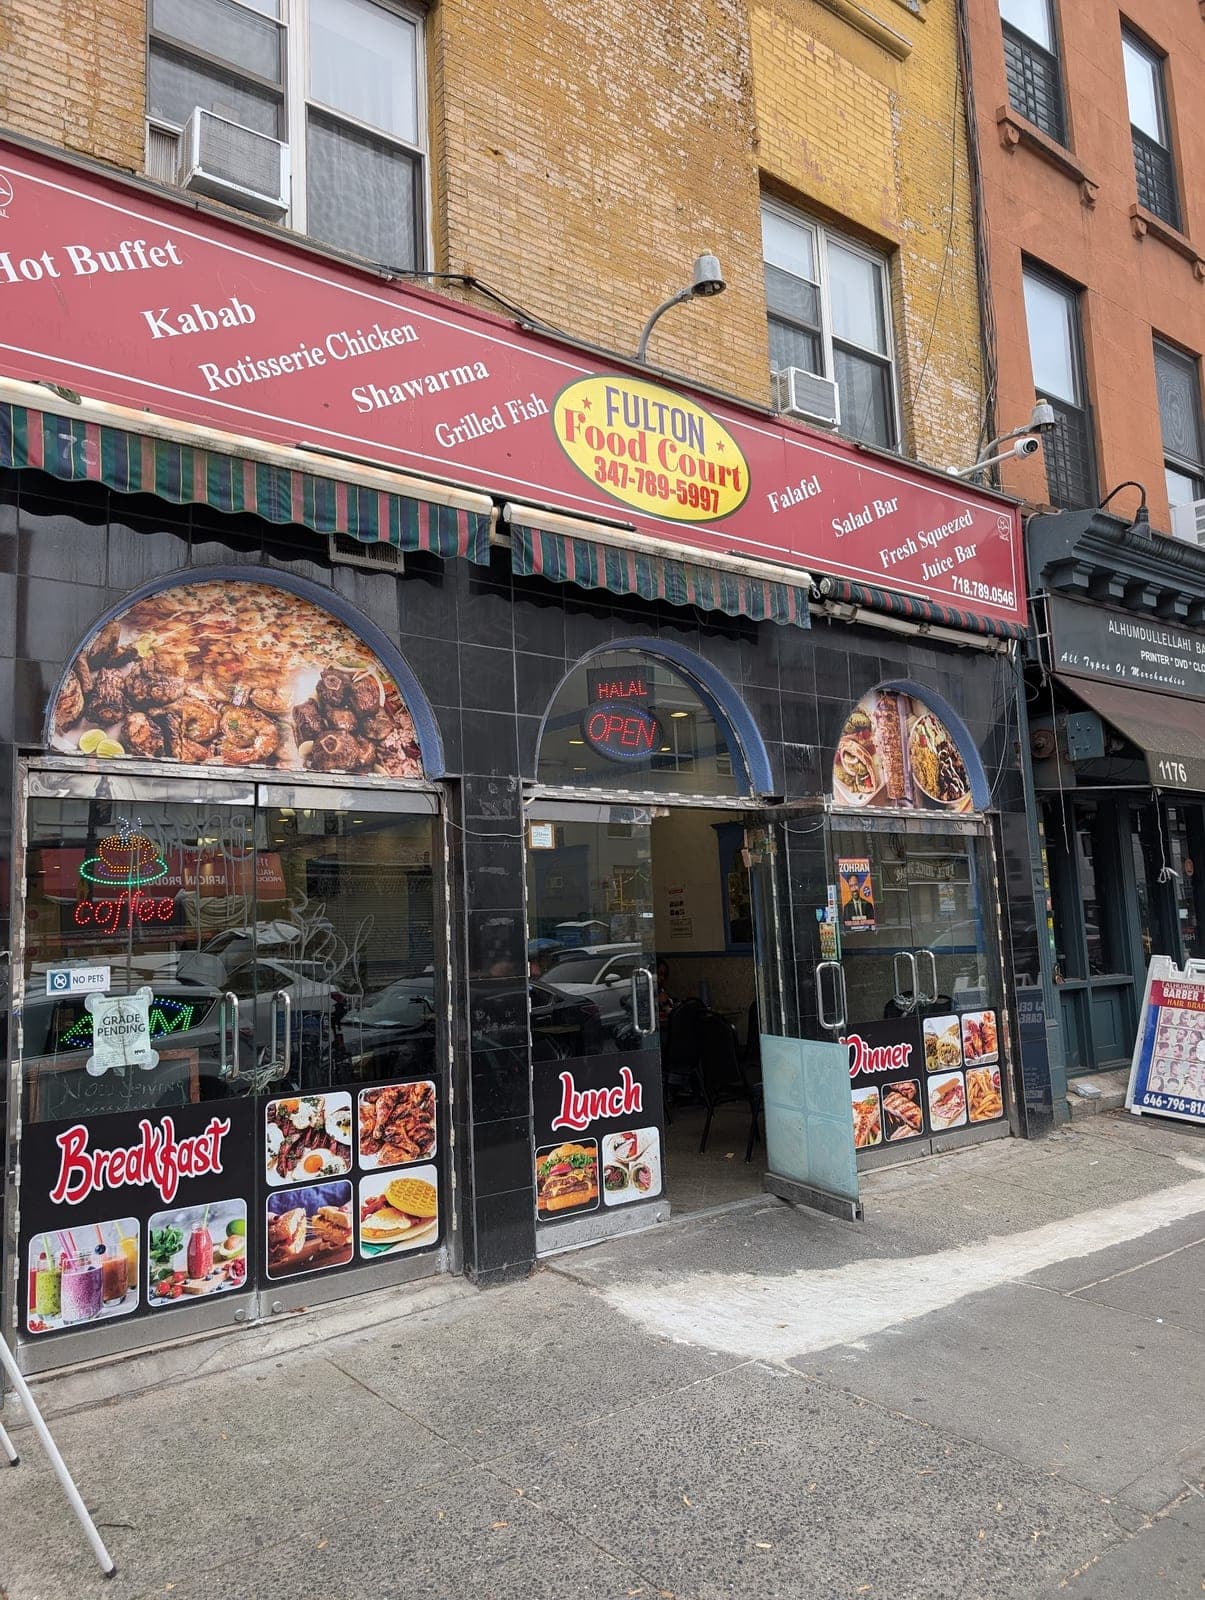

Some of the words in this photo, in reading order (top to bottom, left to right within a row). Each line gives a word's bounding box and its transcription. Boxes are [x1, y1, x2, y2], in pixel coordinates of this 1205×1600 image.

[0, 250, 61, 283] Hot
[62, 239, 183, 276] Buffet
[140, 298, 256, 340] Kabab
[198, 342, 327, 392] Rotisserie
[325, 323, 420, 361] Chicken
[351, 361, 490, 413] Shawarma
[435, 405, 507, 448] Grilled
[505, 392, 550, 425] Fish
[605, 385, 705, 456] FULTON
[563, 407, 648, 465] Food
[657, 438, 742, 493] Court
[594, 455, 720, 514] 347-789-5997
[767, 475, 822, 514] Falafel
[831, 505, 873, 538] Salad
[875, 497, 899, 521] Bar
[879, 541, 918, 569] Fresh
[917, 509, 974, 551] Squeezed
[920, 557, 955, 581] Juice
[954, 543, 978, 566] Bar
[951, 575, 1015, 607] 718.789.0546
[1108, 619, 1192, 652] ALHUMDULLELLAHI
[1060, 651, 1079, 665] All
[1115, 663, 1126, 677] Of
[1140, 650, 1171, 666] PRINTER
[1174, 657, 1189, 670] DVD
[597, 679, 648, 699] HALAL
[588, 712, 657, 748] OPEN
[1158, 759, 1187, 783] 1176
[838, 863, 870, 873] ZOHRAN
[74, 889, 175, 935] coffee
[72, 974, 86, 985] NO
[88, 972, 105, 984] PETS
[1162, 986, 1199, 1002] BARBER
[61, 1005, 194, 1042] AM
[97, 1023, 146, 1037] PENDING
[102, 1013, 141, 1026] GRADE
[838, 1033, 912, 1078] Dinner
[551, 1066, 643, 1132] Lunch
[50, 1115, 231, 1205] Breakfast
